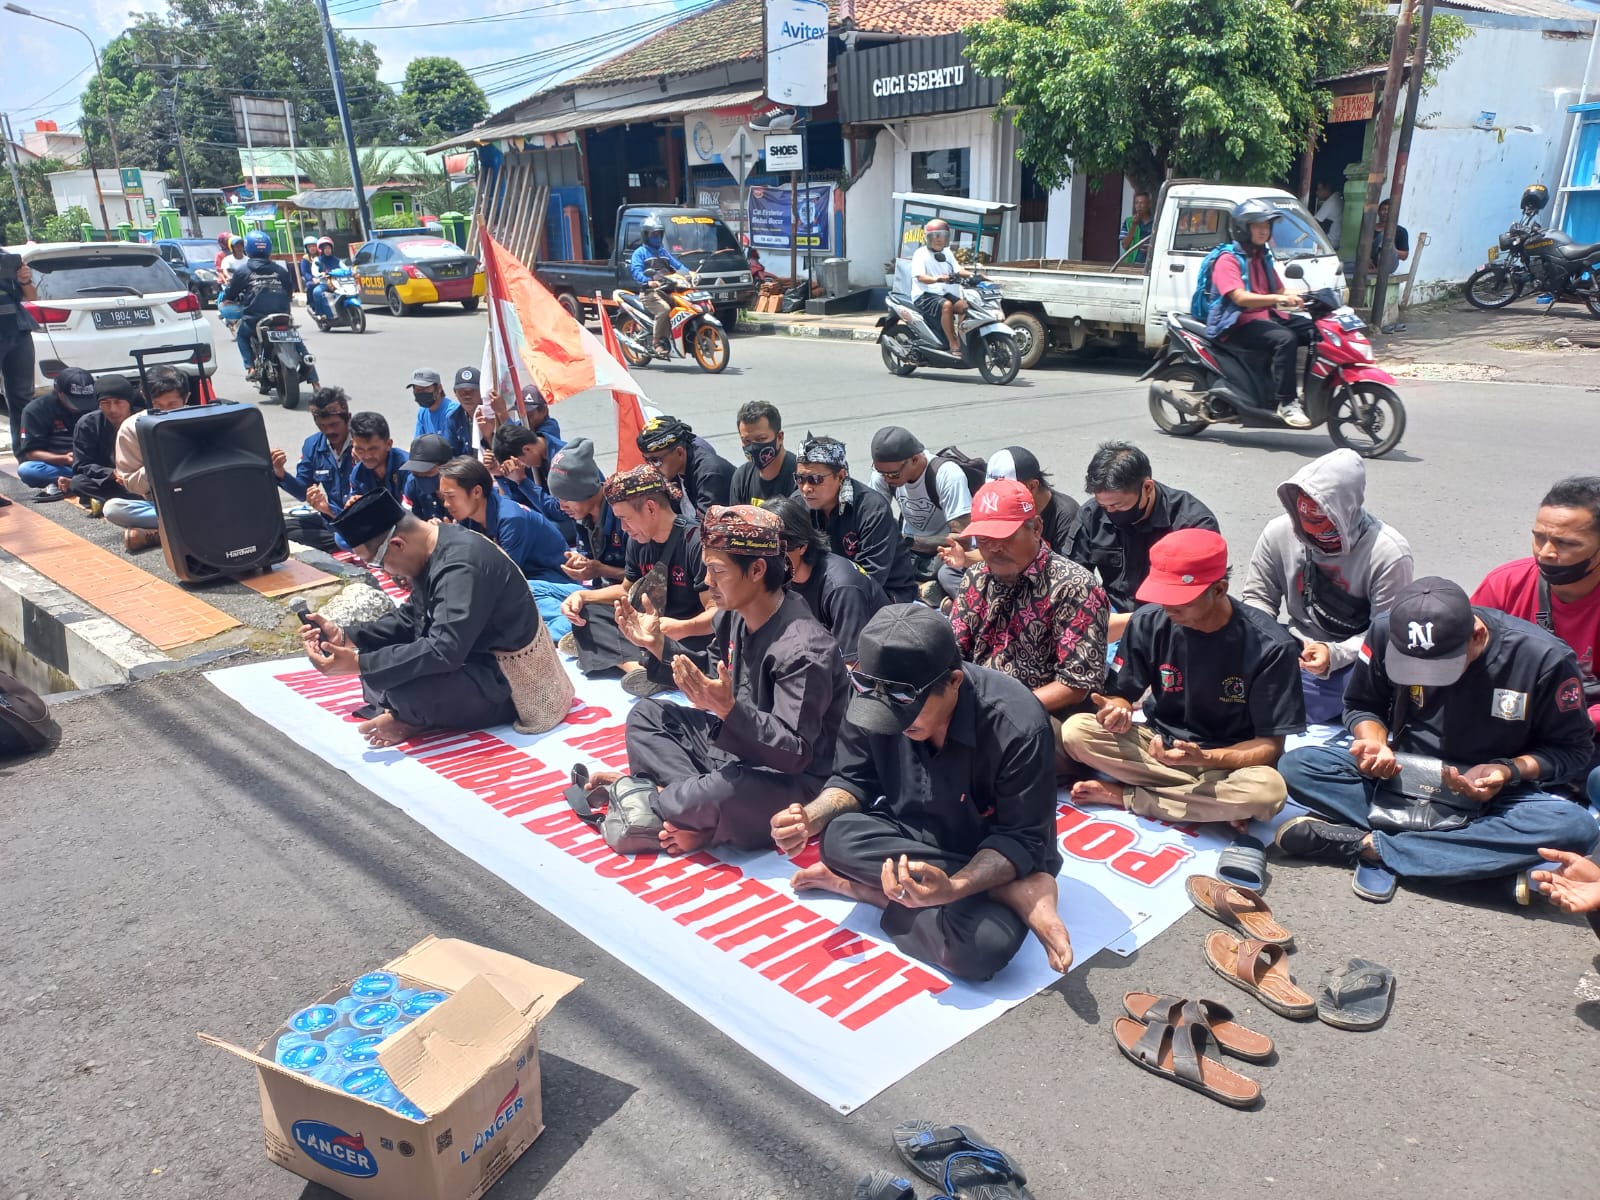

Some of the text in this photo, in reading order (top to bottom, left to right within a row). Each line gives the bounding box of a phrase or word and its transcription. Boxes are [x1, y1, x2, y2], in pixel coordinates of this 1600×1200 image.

[780, 21, 825, 40] Avitex
[873, 65, 965, 97] CUCI SEPATU
[770, 145, 798, 156] SHOES
[361, 276, 384, 288] POLISI
[95, 312, 102, 322] D
[1056, 803, 1191, 886] POL
[460, 1095, 524, 1166] LANCER
[295, 1127, 371, 1170] LANCER
